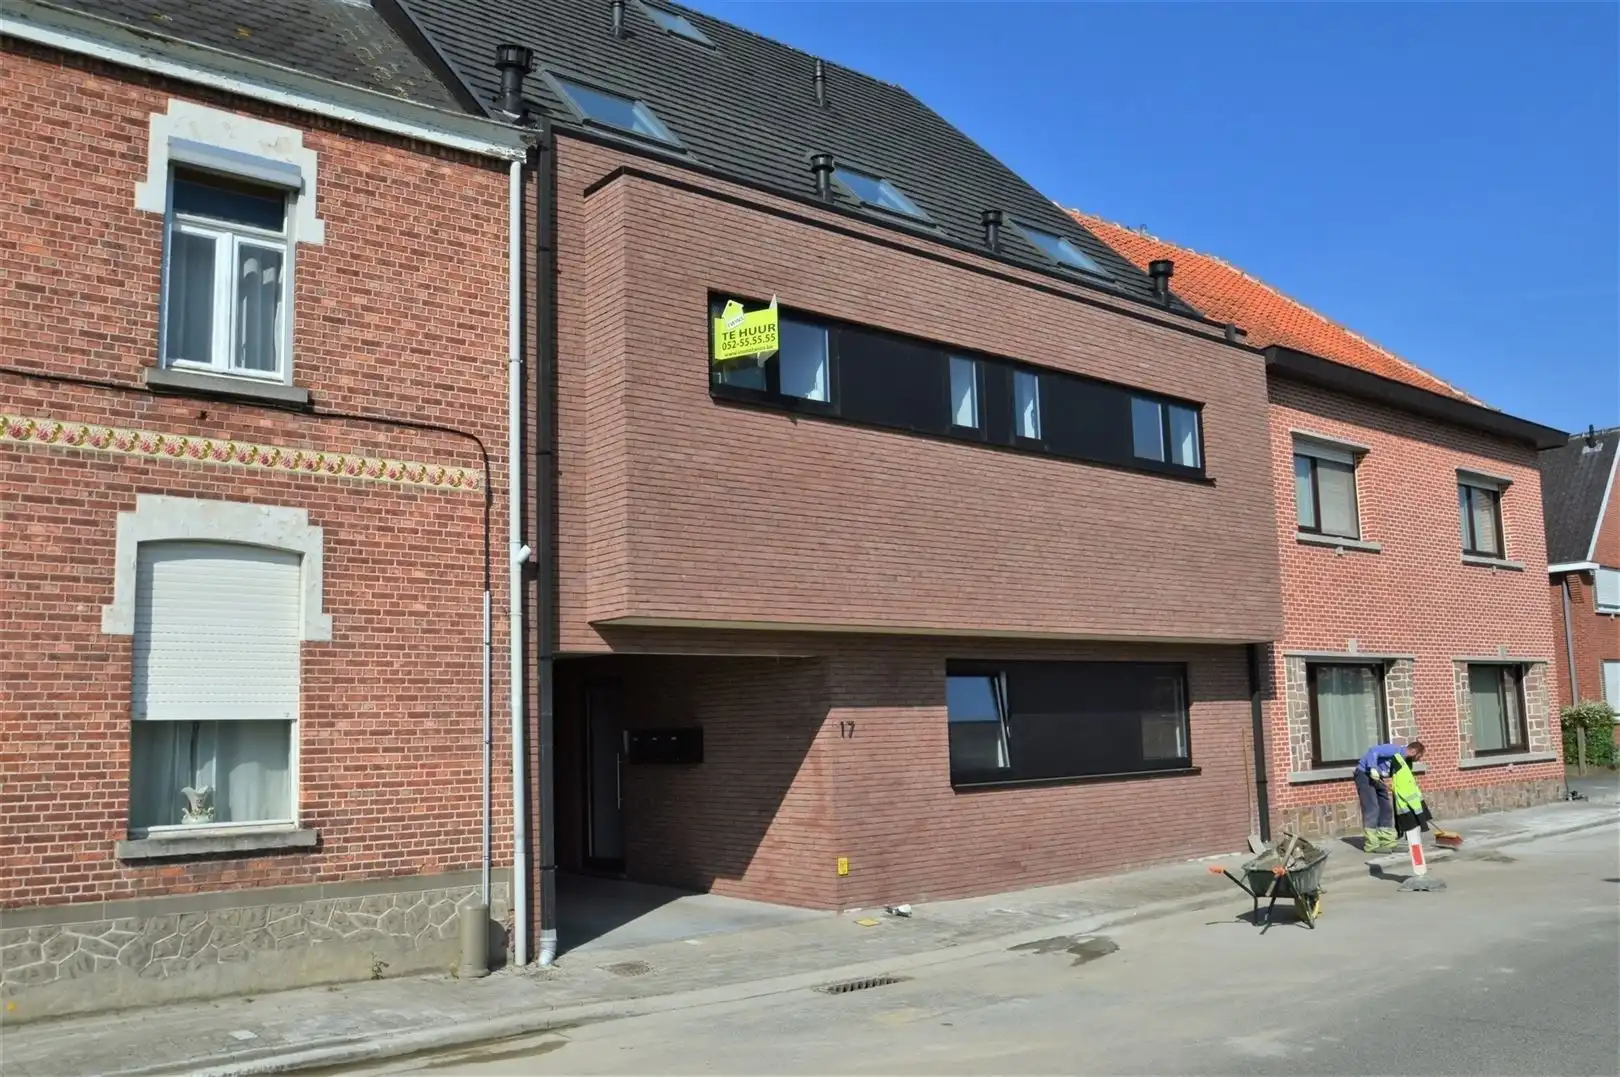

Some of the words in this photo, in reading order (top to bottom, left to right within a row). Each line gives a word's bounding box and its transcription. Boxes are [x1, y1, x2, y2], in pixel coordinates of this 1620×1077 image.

[722, 331, 736, 341] TE
[739, 324, 776, 338] HUUR
[722, 333, 776, 351] 052-55.55.55
[840, 721, 855, 739] 17
